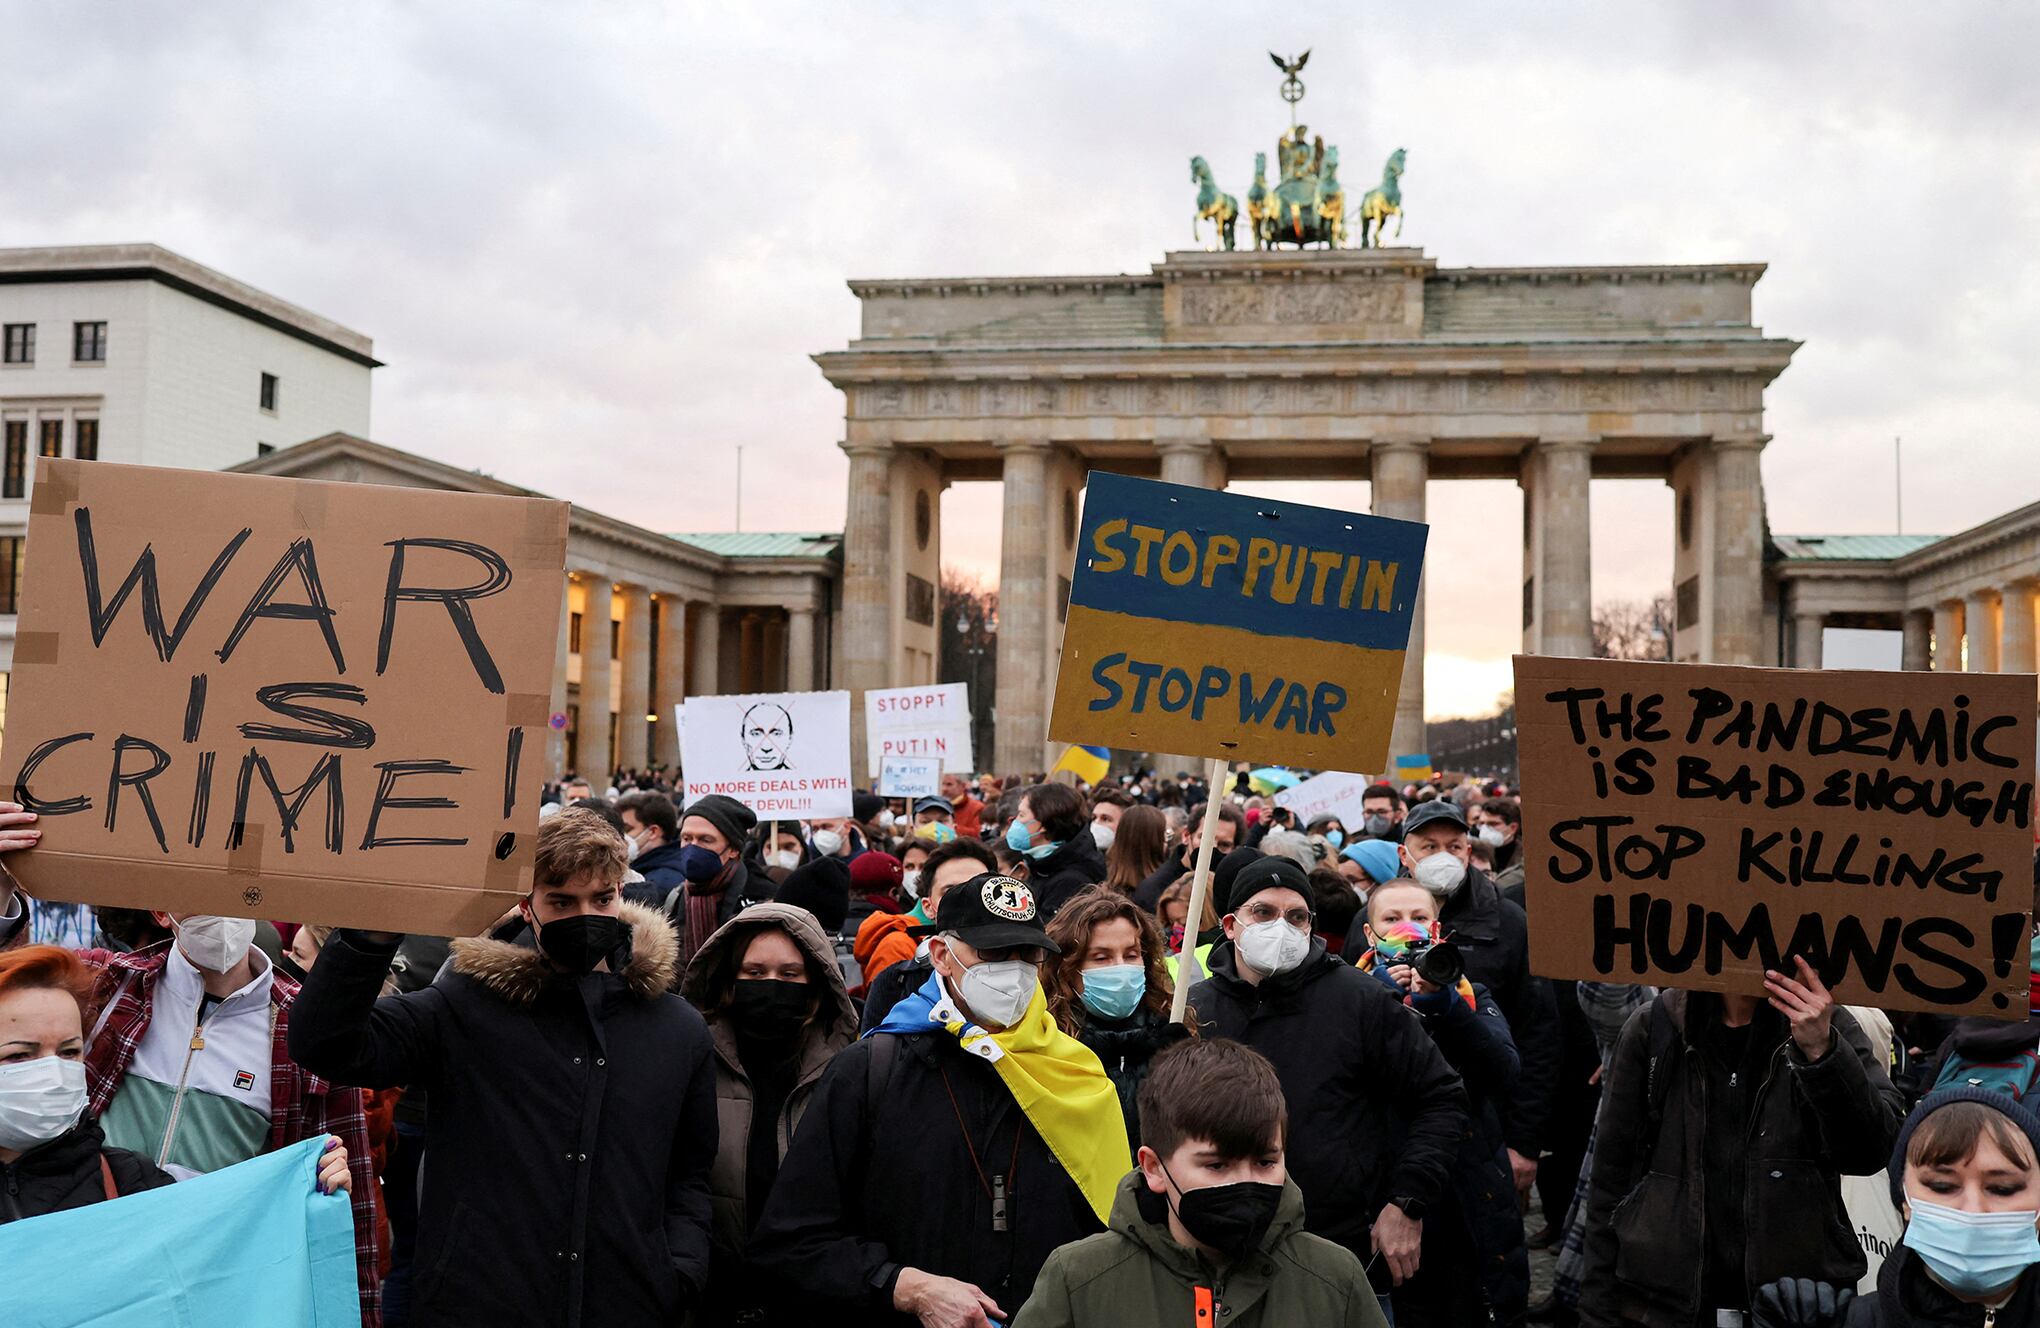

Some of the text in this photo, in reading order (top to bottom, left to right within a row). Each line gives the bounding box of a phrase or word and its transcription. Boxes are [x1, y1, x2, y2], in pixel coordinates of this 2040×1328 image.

[75, 507, 512, 694] WAR
[1092, 519, 1399, 613] STOP PUTIN
[184, 673, 376, 749] IS
[878, 693, 945, 712] STOPPT
[1089, 653, 1347, 737] STOP WAR
[1546, 688, 1670, 744] THE
[884, 738, 945, 754] PUTIN
[15, 727, 522, 860] CRIME!
[690, 778, 847, 794] NO MORE DEALS WITH
[757, 798, 811, 811] DEVIL!!!
[1677, 756, 1805, 808] BAD
[1814, 768, 2032, 829] ENOUGH
[1548, 816, 1705, 884] STOP
[1593, 893, 2026, 1010] HUMANS!
